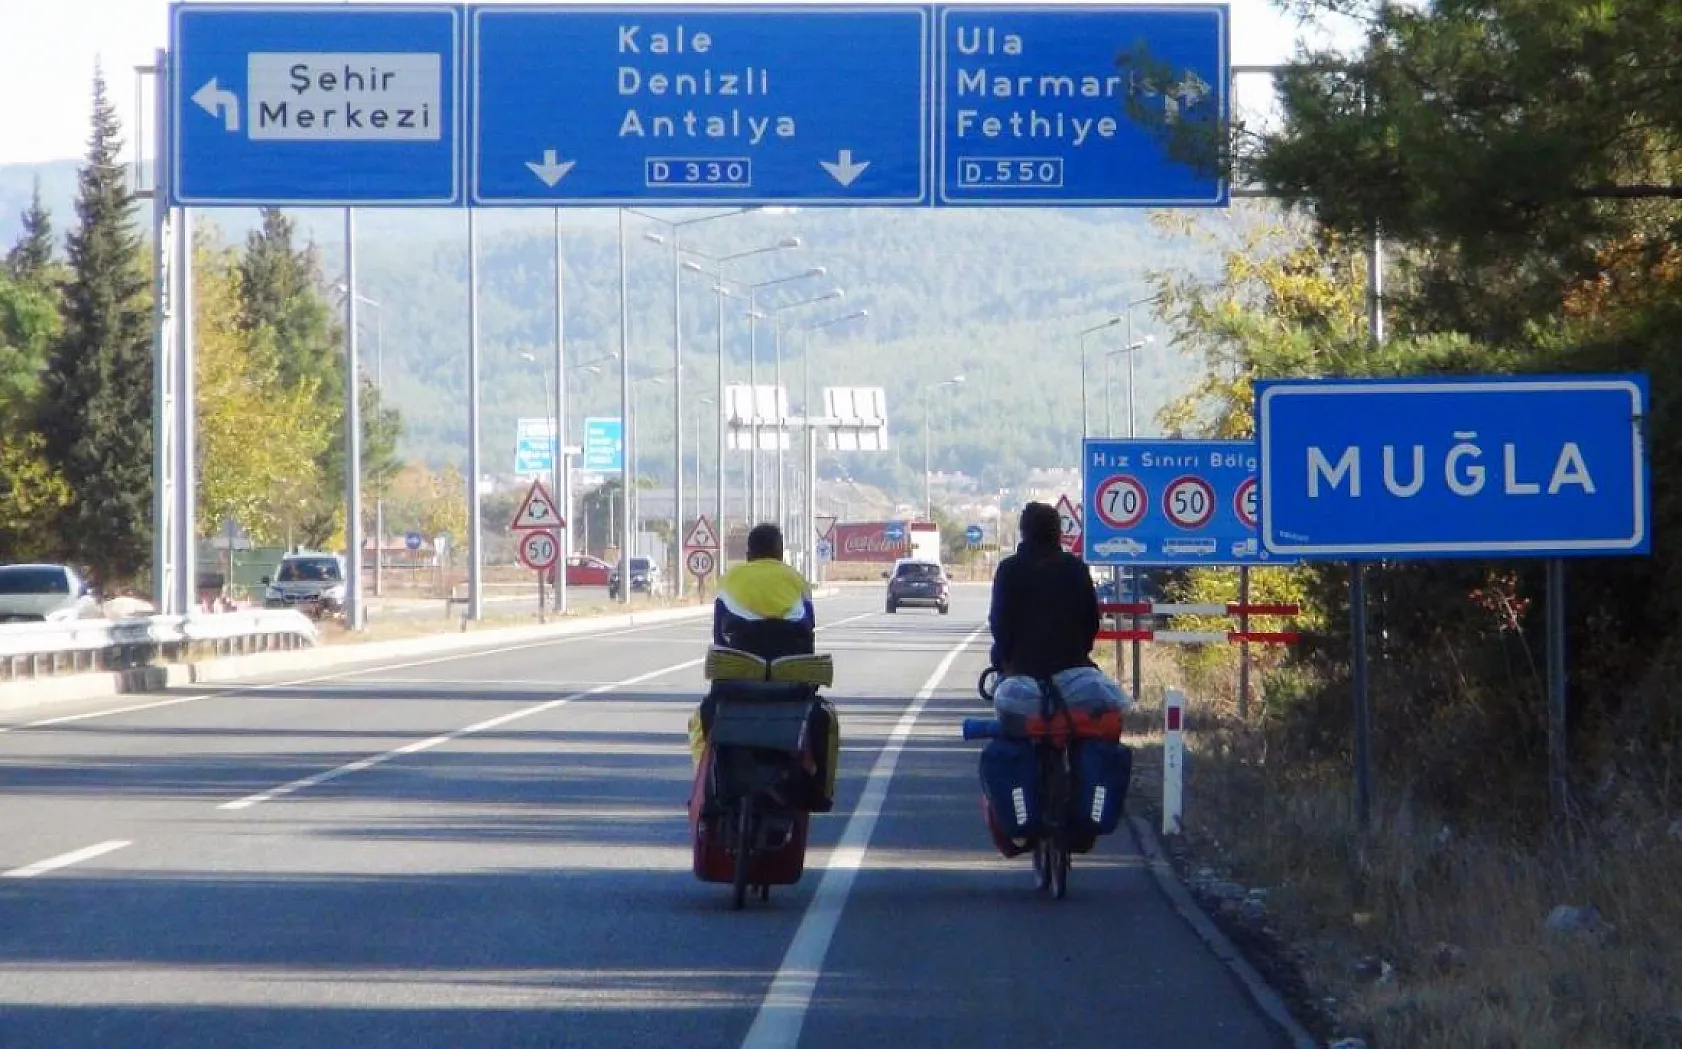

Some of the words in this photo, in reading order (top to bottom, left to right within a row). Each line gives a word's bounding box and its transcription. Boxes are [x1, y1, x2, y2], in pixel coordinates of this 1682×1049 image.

[618, 25, 712, 54] Kale
[957, 26, 1023, 55] Ula
[290, 63, 396, 95] Şehir
[618, 66, 768, 96] Denizli
[259, 101, 429, 128] Merkezi
[618, 109, 796, 145] Antalya
[957, 109, 1117, 146] Fethiye
[652, 163, 669, 181] D
[685, 162, 743, 181] 330
[1306, 431, 1597, 498] MUĞLA
[1106, 490, 1137, 514] 70
[1175, 490, 1204, 514] 50
[529, 541, 553, 559] 50
